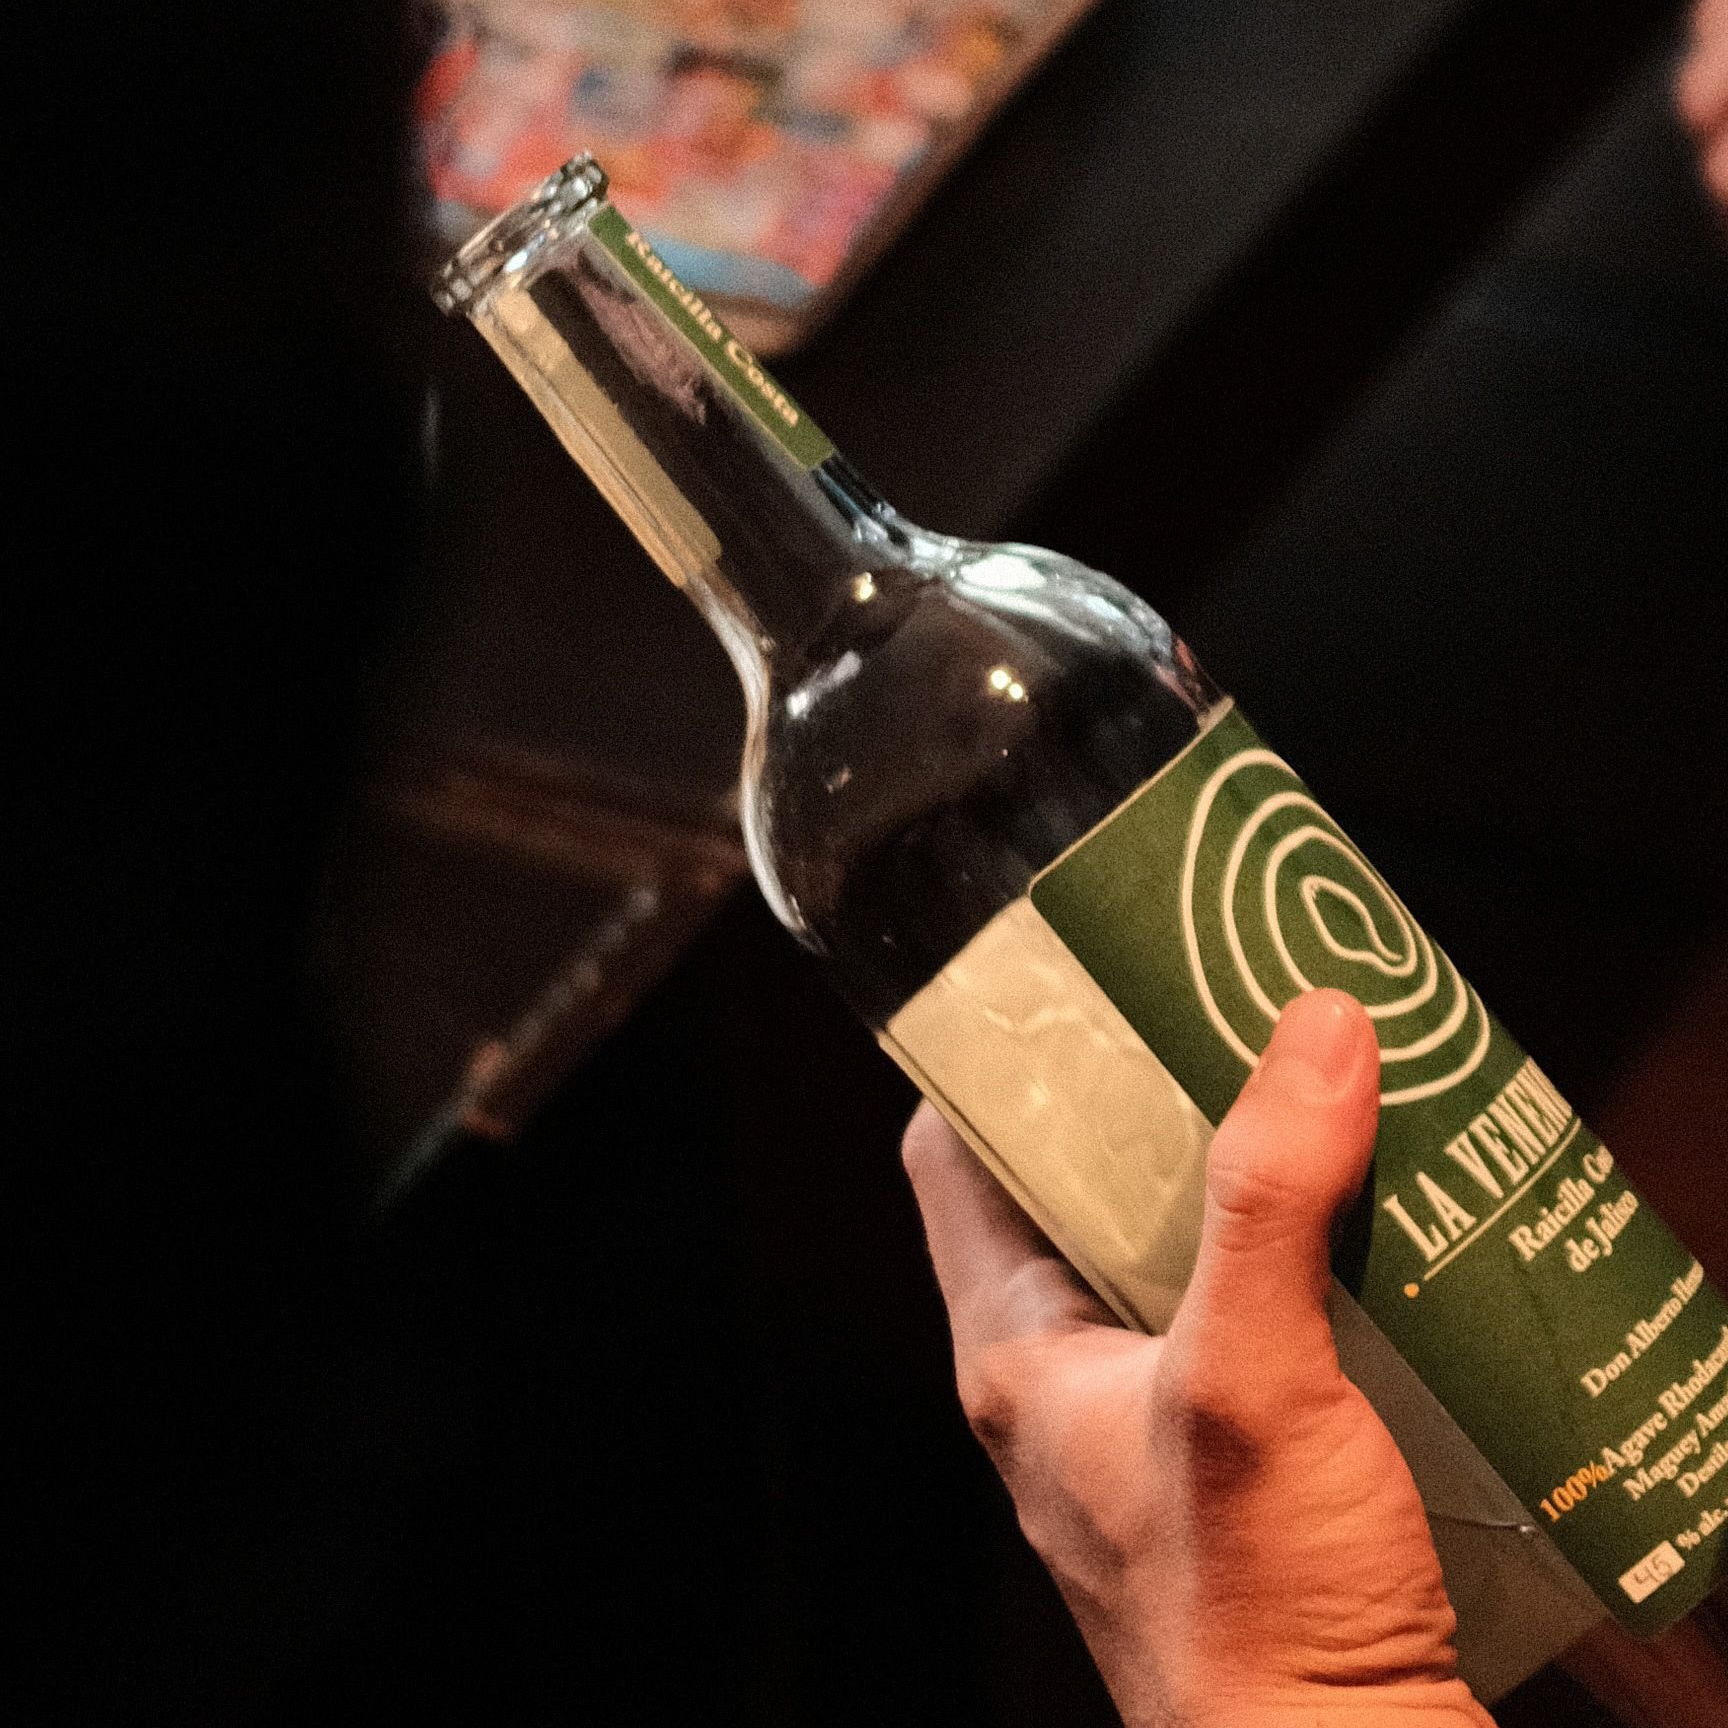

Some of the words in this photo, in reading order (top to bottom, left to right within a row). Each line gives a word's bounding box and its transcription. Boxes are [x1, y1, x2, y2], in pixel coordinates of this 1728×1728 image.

[724, 340, 799, 427] Costa
[1383, 1171, 1478, 1263] LA
[1508, 1176, 1596, 1263] Raicilla
[1565, 1237, 1600, 1273] de
[1580, 1351, 1632, 1398] Don
[1625, 1297, 1683, 1360] Alberto
[1622, 1429, 1701, 1502] Maguey
